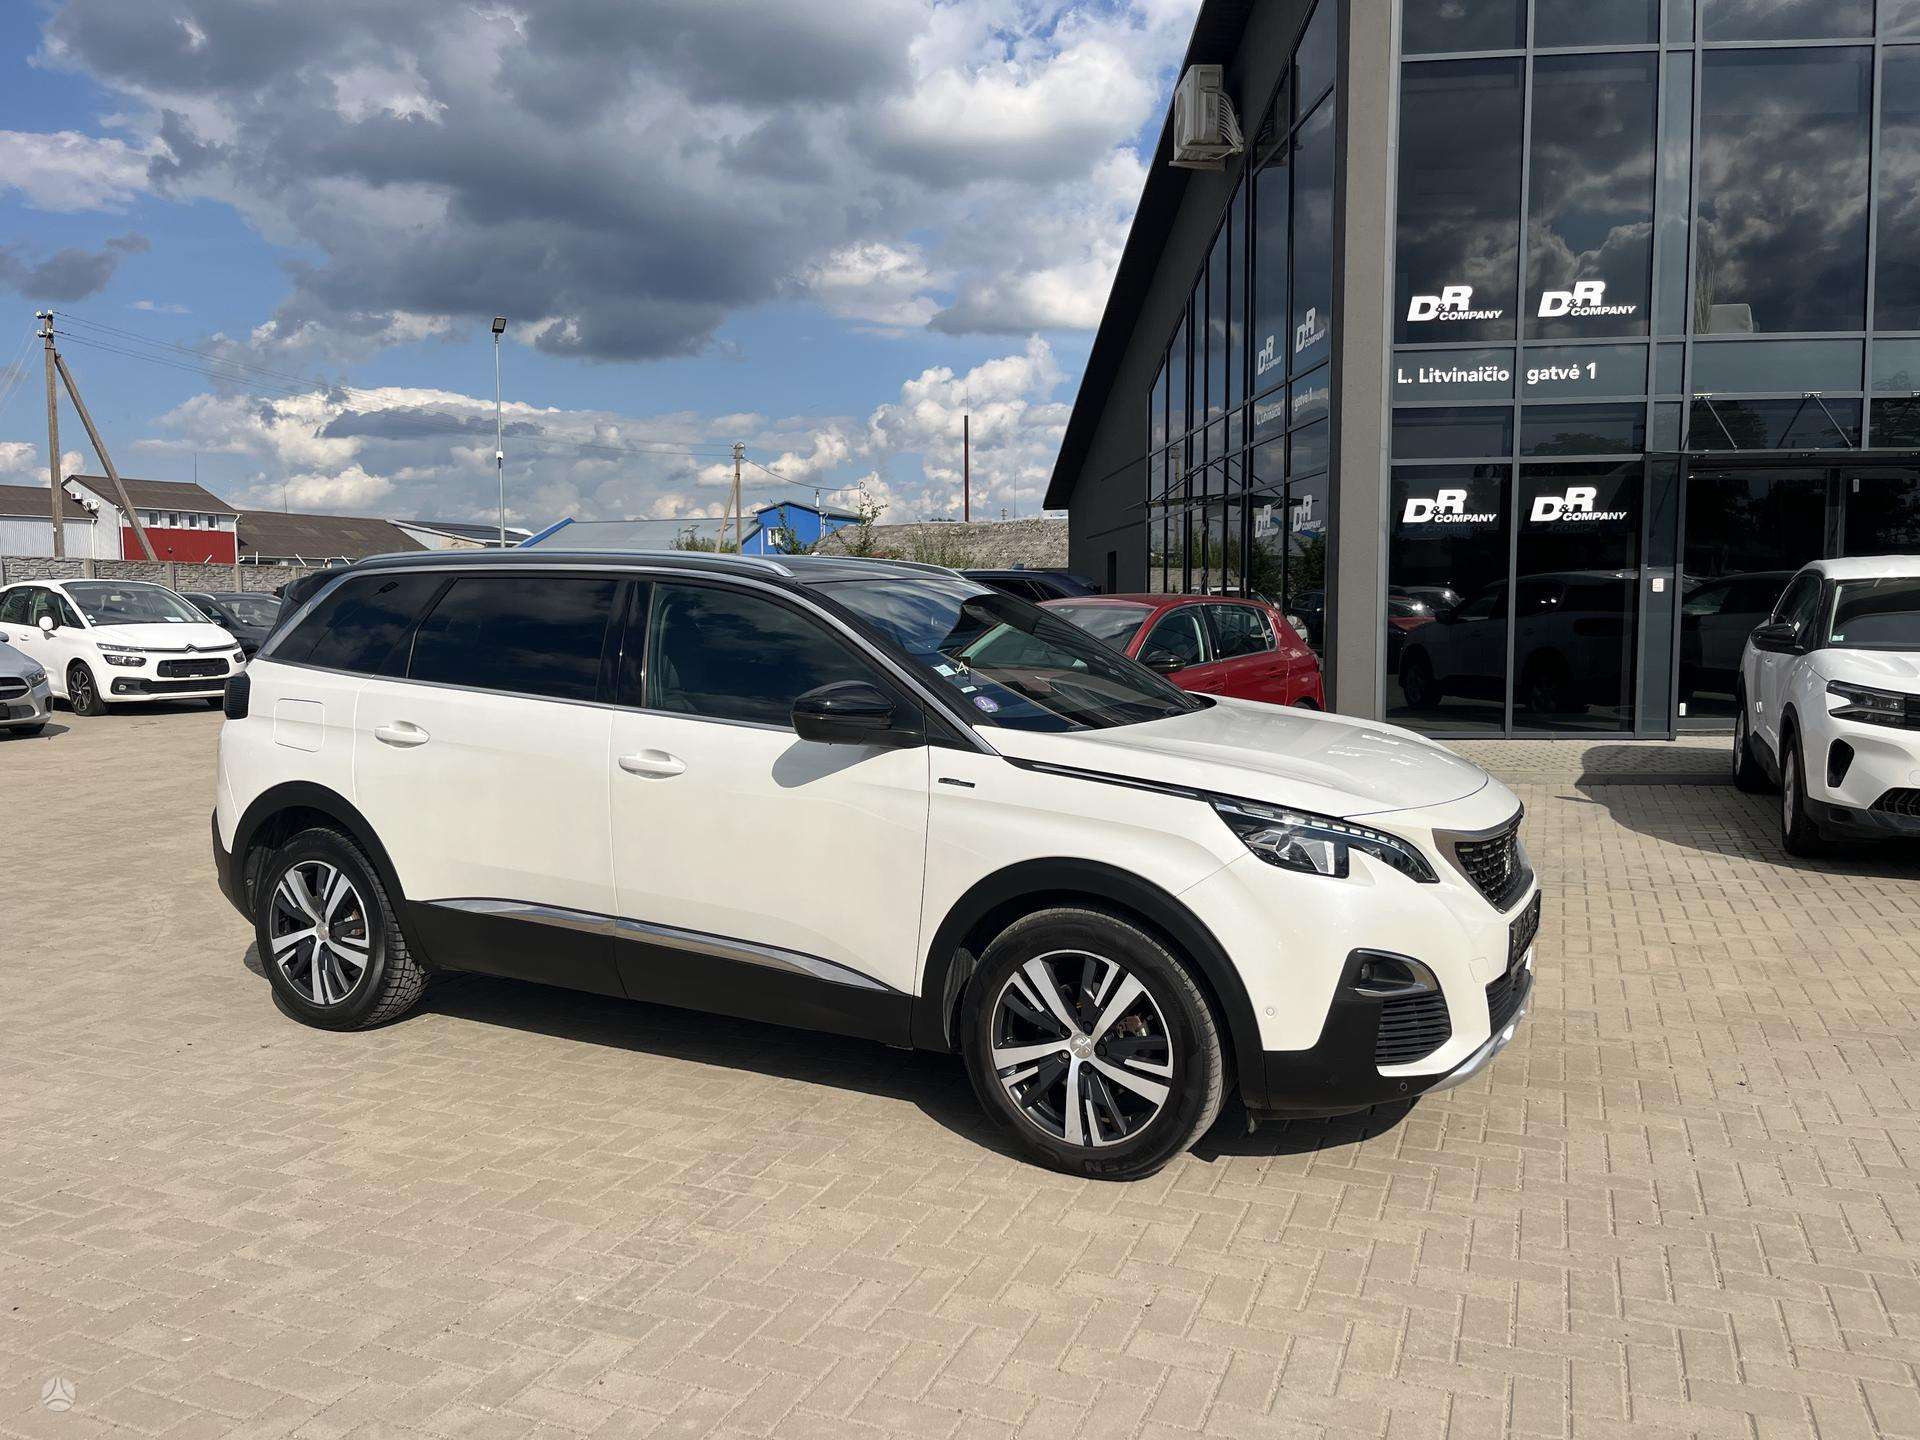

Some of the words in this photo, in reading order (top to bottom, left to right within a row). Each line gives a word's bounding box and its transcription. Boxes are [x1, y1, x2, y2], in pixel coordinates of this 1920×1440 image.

[1407, 286, 1473, 321] D&R
[1538, 281, 1606, 317] D&R
[1570, 305, 1637, 316] COMPANY
[1439, 310, 1503, 321] COMPANY
[1397, 368, 1413, 384] L.
[1419, 366, 1510, 383] Litvinaičio
[1526, 363, 1580, 385] gatvė
[1585, 362, 1597, 380] 1
[1292, 494, 1313, 533] DR
[1402, 489, 1468, 523] D&R
[1434, 513, 1497, 523] COMPANY
[1530, 487, 1597, 522] D&R
[1562, 511, 1628, 521] COMPANY
